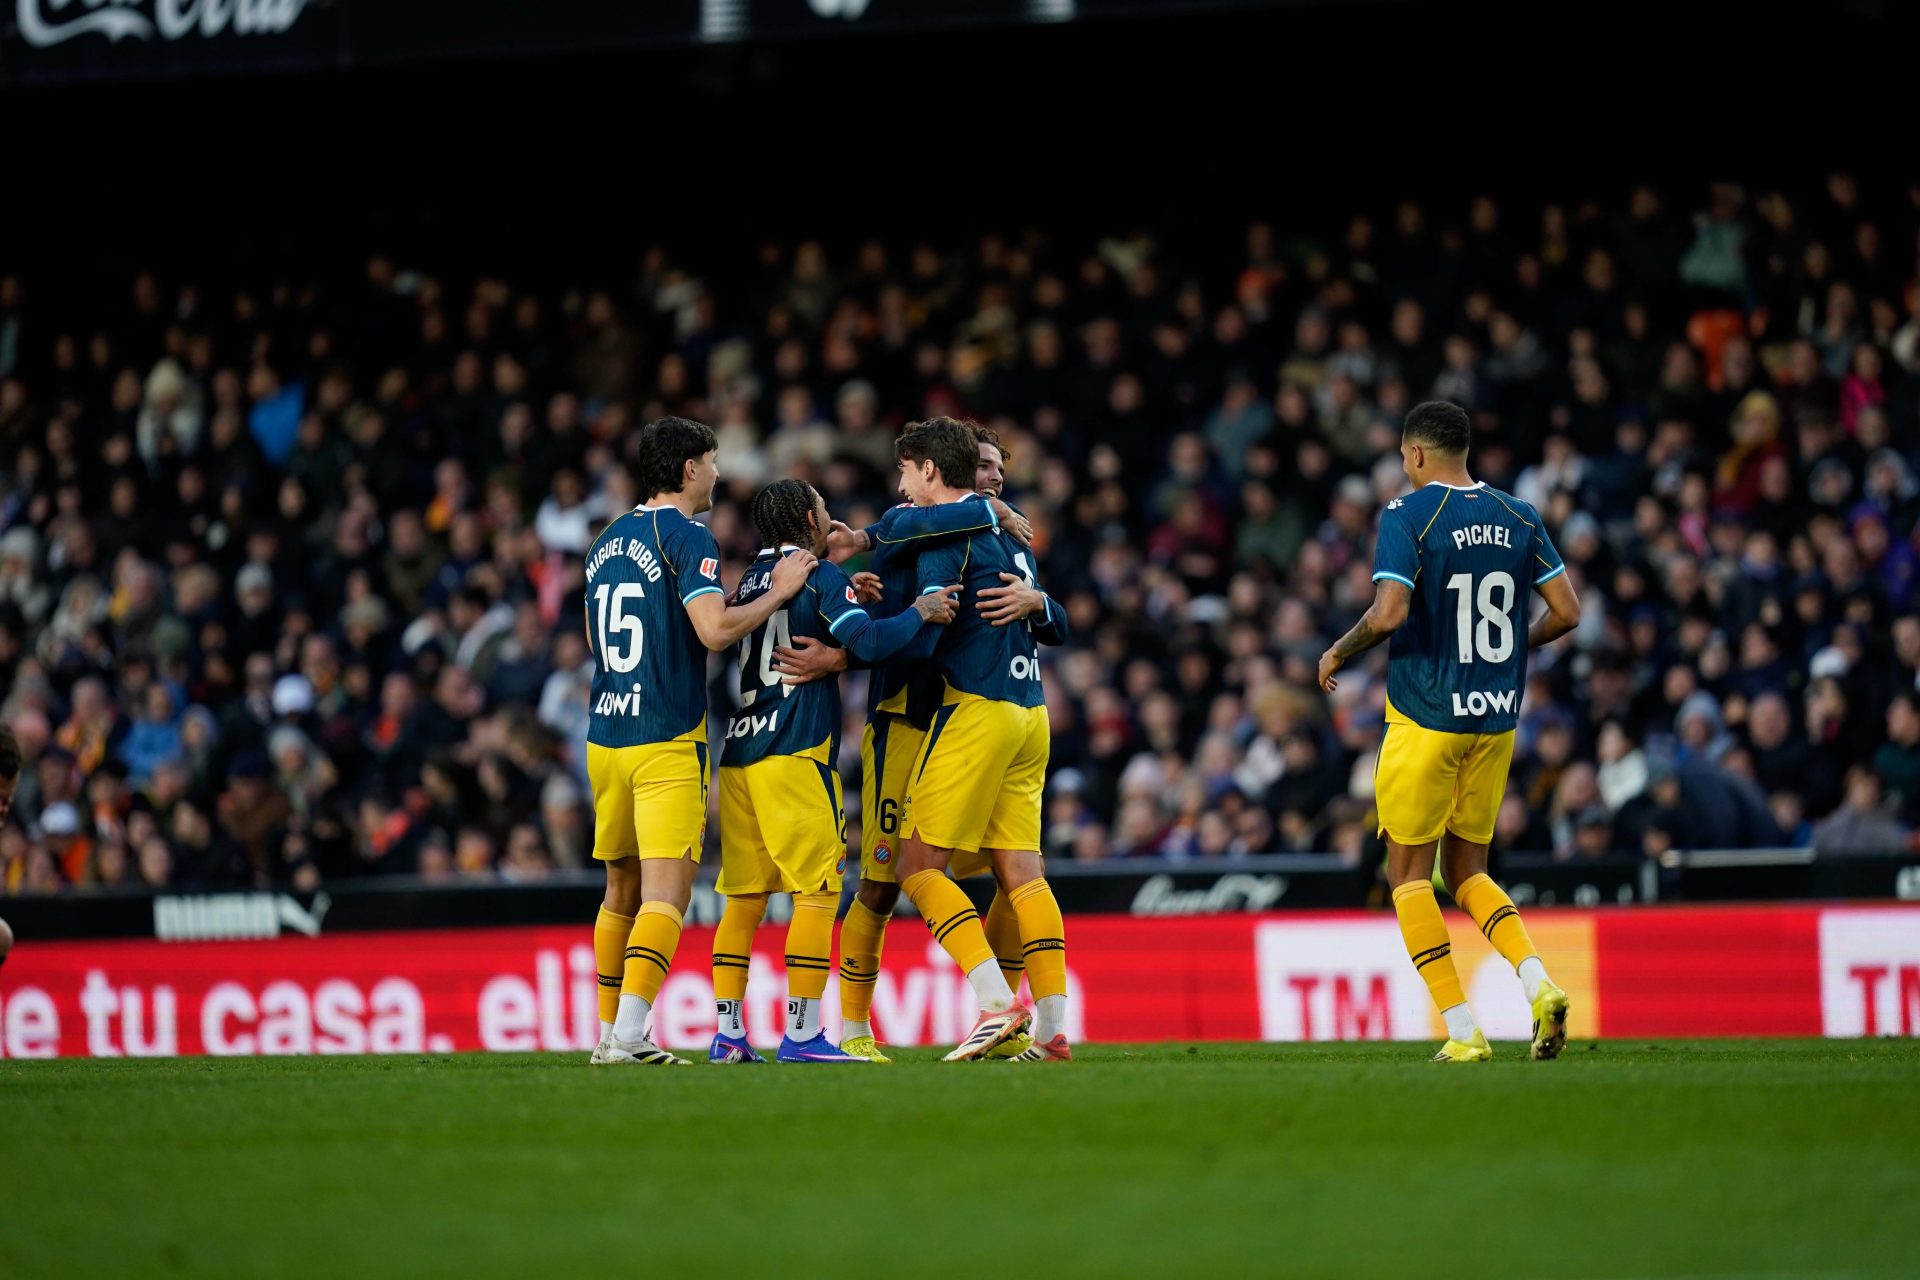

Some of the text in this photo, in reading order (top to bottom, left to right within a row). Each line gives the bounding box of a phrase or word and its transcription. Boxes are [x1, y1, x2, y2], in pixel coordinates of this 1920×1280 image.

[1452, 525, 1511, 550] PICKEL
[586, 537, 662, 583] MIGUEL RUBIO
[740, 571, 773, 600] DOLA
[594, 582, 645, 673] 15
[1446, 571, 1515, 664] 18
[1452, 690, 1517, 717] LOW
[880, 798, 898, 834] 6
[79, 969, 178, 1058] tu
[200, 975, 455, 1055] casa.
[478, 942, 718, 1050] elie
